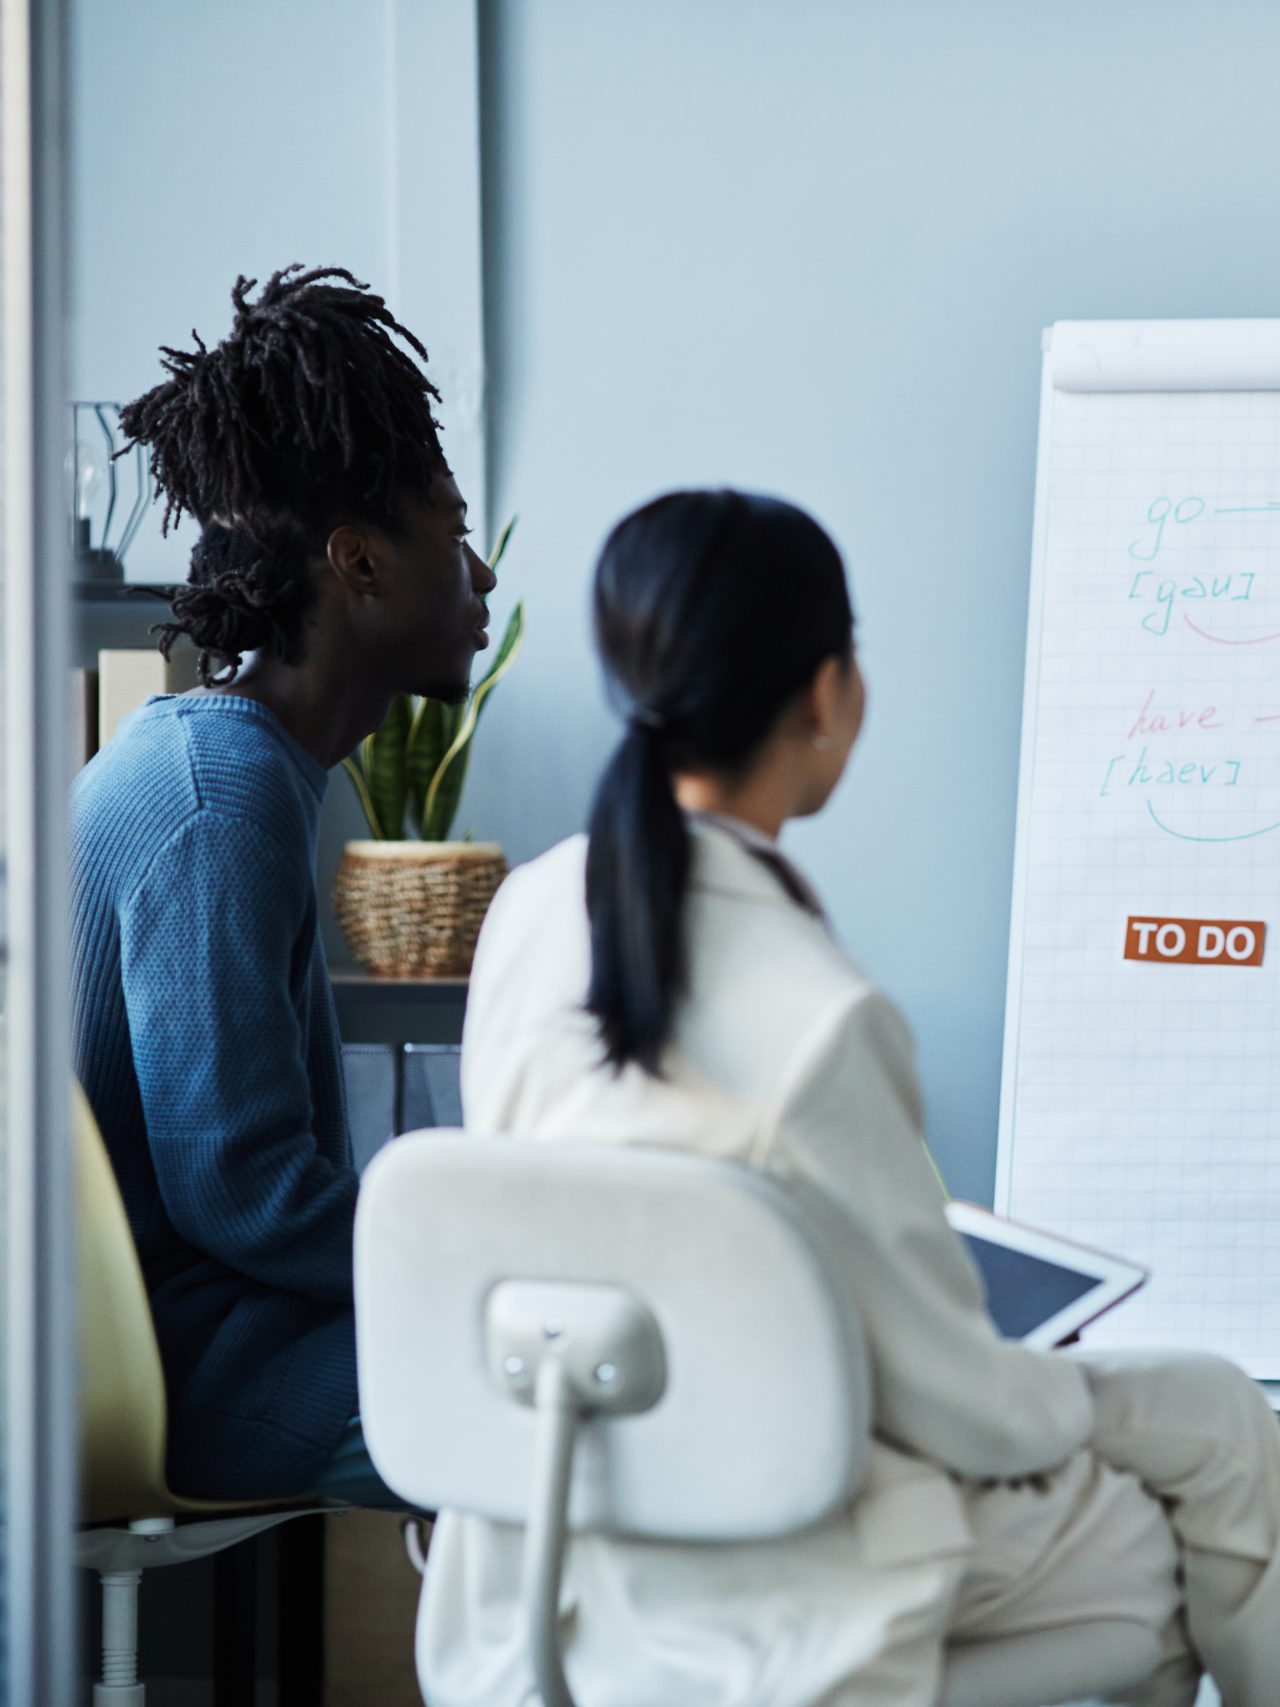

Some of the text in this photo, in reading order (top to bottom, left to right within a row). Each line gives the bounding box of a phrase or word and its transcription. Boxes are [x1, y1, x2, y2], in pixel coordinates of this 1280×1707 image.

[1128, 496, 1206, 561] go
[1127, 689, 1226, 740] have
[1132, 922, 1256, 960] TO DO
